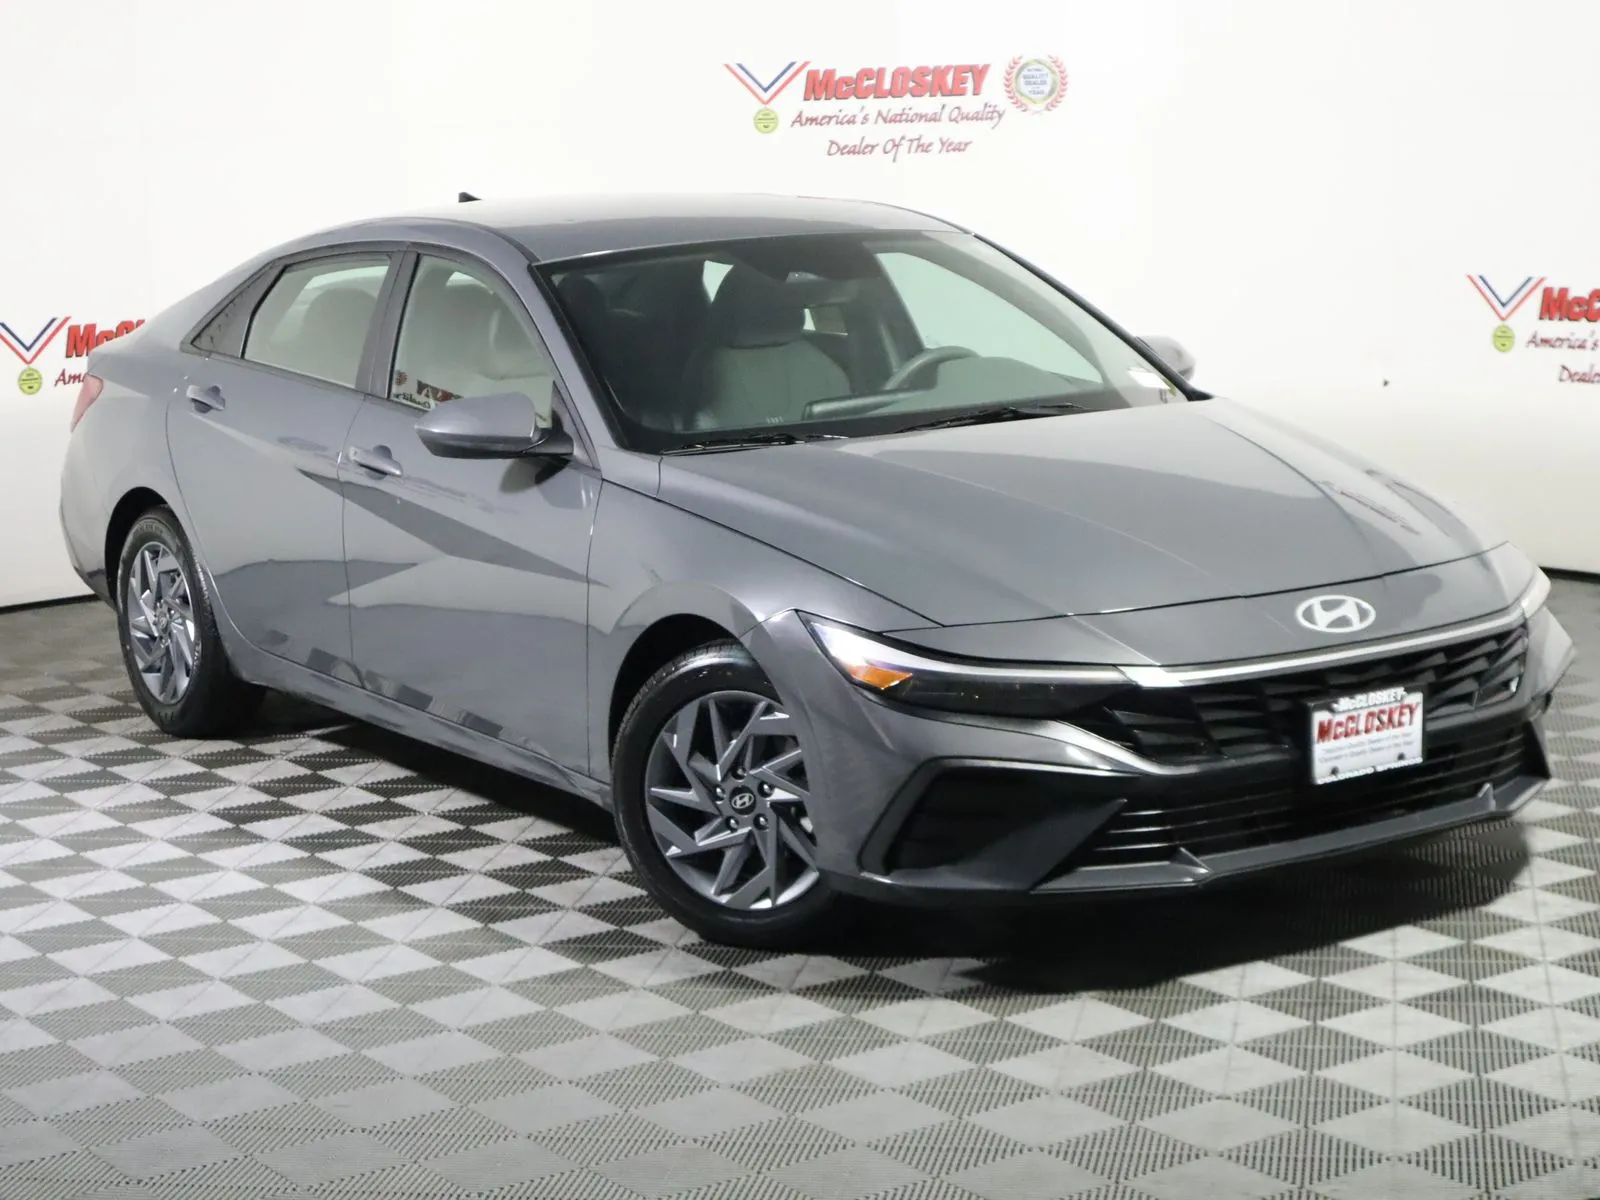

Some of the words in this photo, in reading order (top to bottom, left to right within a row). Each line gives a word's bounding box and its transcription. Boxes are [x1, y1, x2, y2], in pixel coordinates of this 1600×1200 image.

[803, 64, 990, 101] McCLOSKEY
[791, 105, 870, 128] America's
[874, 103, 946, 125] National
[948, 102, 1006, 129] Quality
[827, 136, 880, 157] Dealer
[883, 135, 906, 163] Of
[906, 135, 934, 155] The
[937, 136, 973, 155] Year
[1317, 703, 1420, 744] McCLOSKEY
